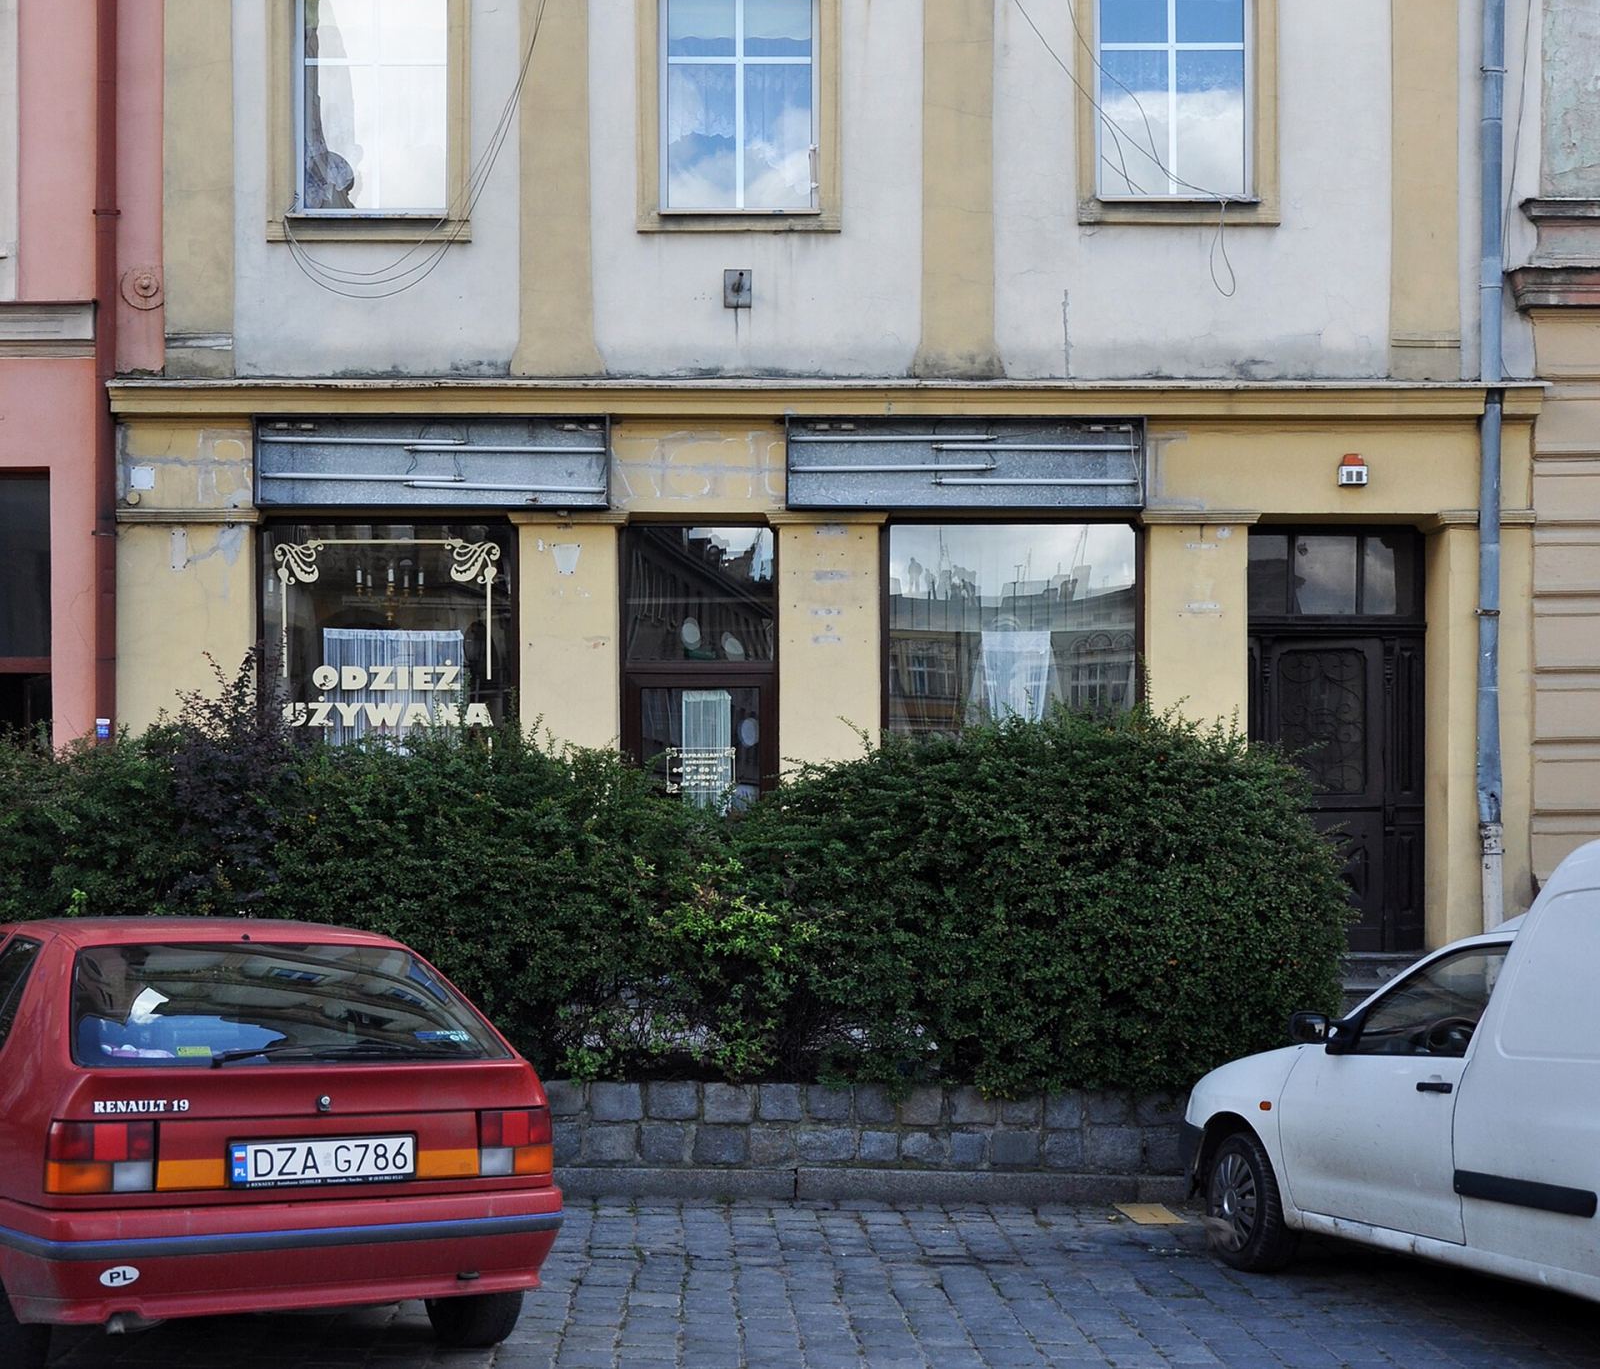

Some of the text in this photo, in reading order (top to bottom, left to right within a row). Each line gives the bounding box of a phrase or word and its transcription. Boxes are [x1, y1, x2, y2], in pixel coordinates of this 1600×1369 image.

[312, 659, 461, 691] ODZIEŻ
[94, 1099, 189, 1113] RENAULT 19
[253, 1142, 408, 1178] DZA G786
[234, 1168, 246, 1177] PL
[110, 1270, 134, 1283] PL
